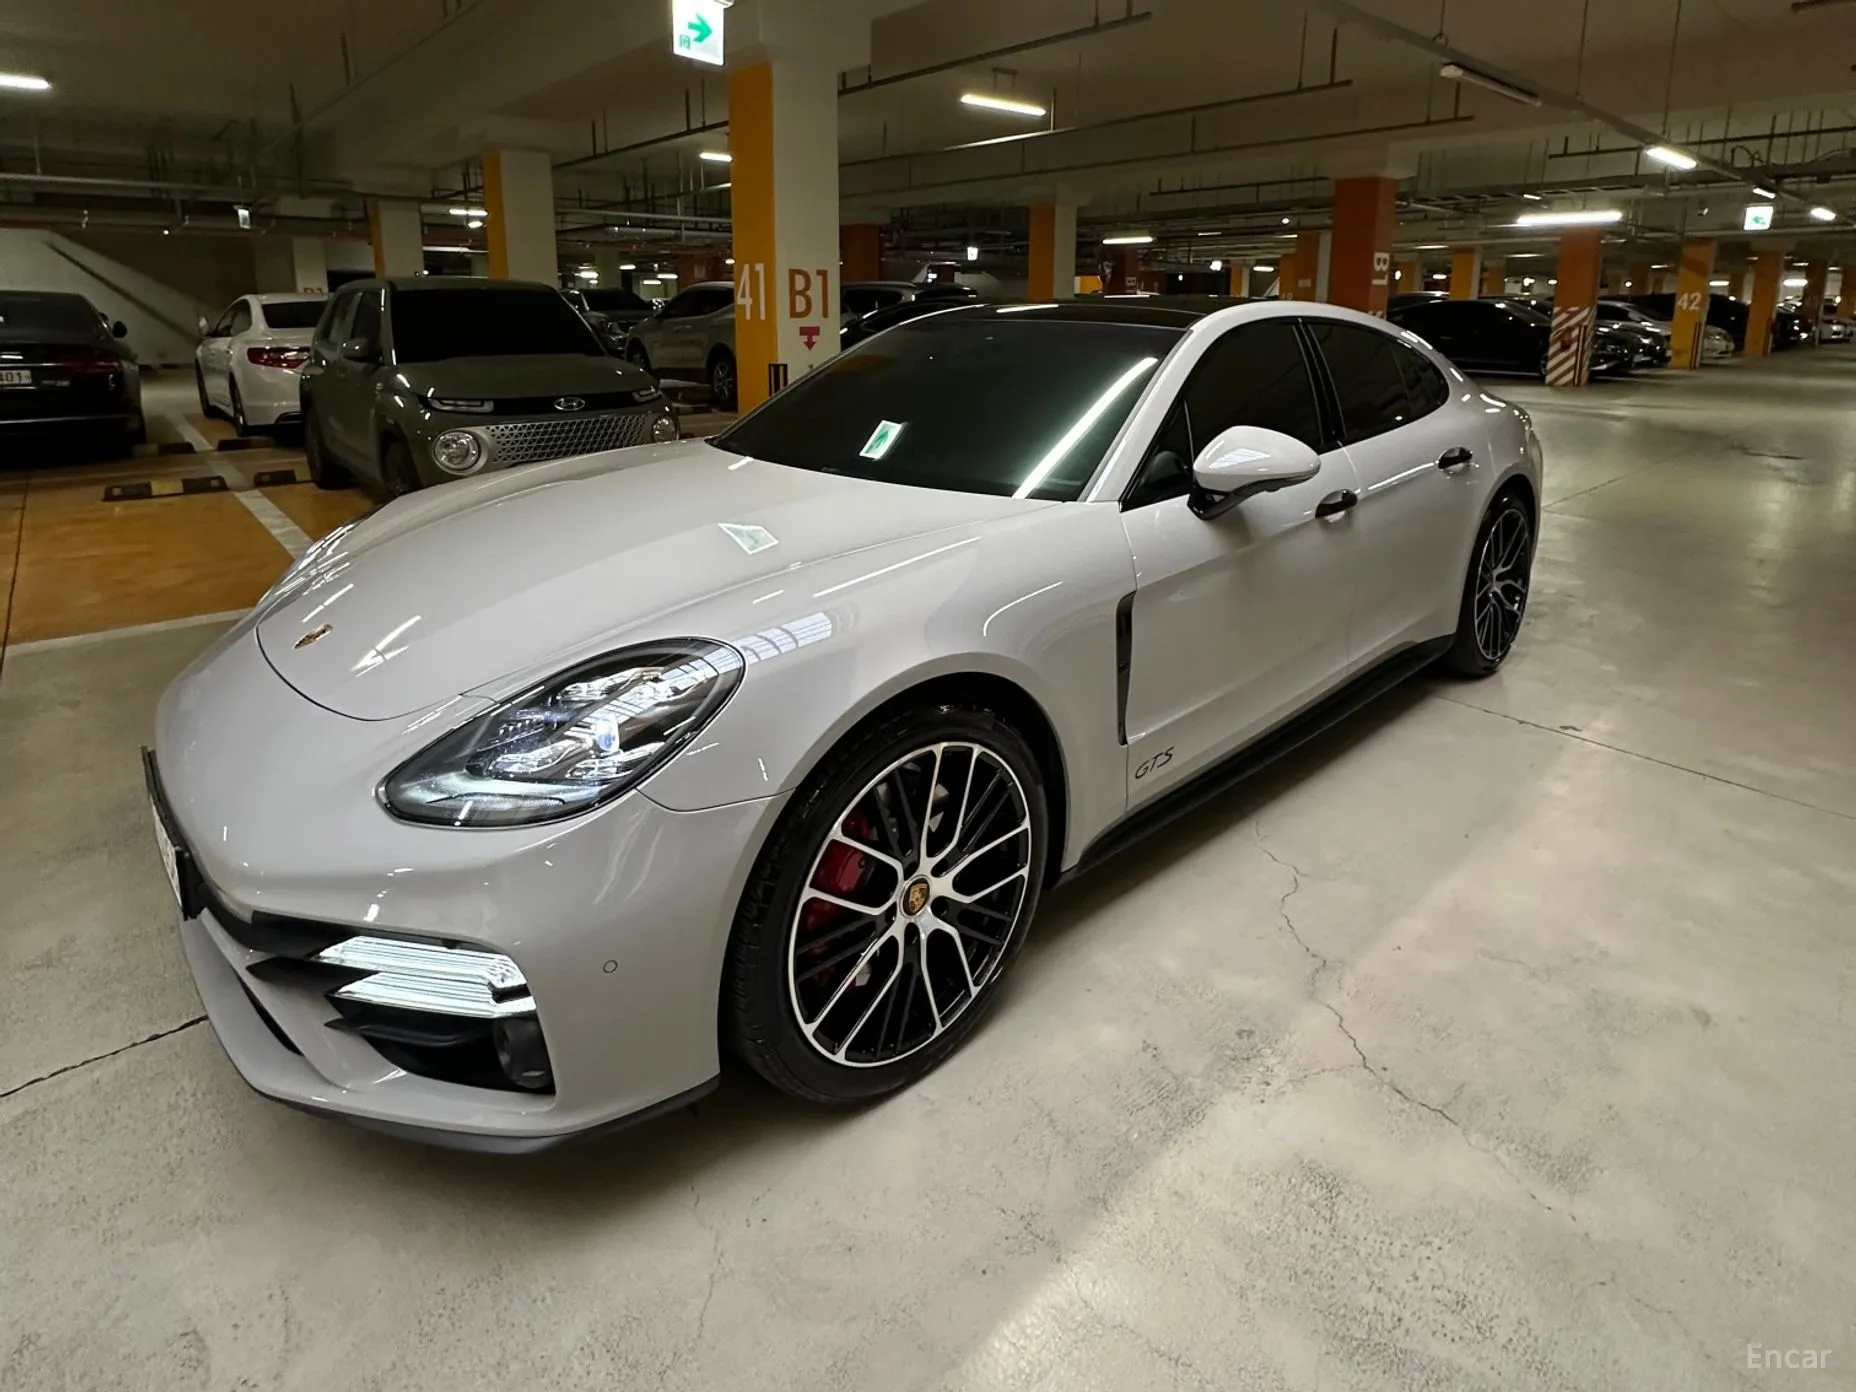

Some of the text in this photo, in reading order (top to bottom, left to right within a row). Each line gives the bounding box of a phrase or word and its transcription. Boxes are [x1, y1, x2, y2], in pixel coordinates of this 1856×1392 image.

[1371, 252, 1390, 285] B1
[737, 263, 766, 320] 41
[788, 268, 829, 319] B1
[1676, 292, 1702, 310] 42
[1135, 746, 1175, 779] GTS
